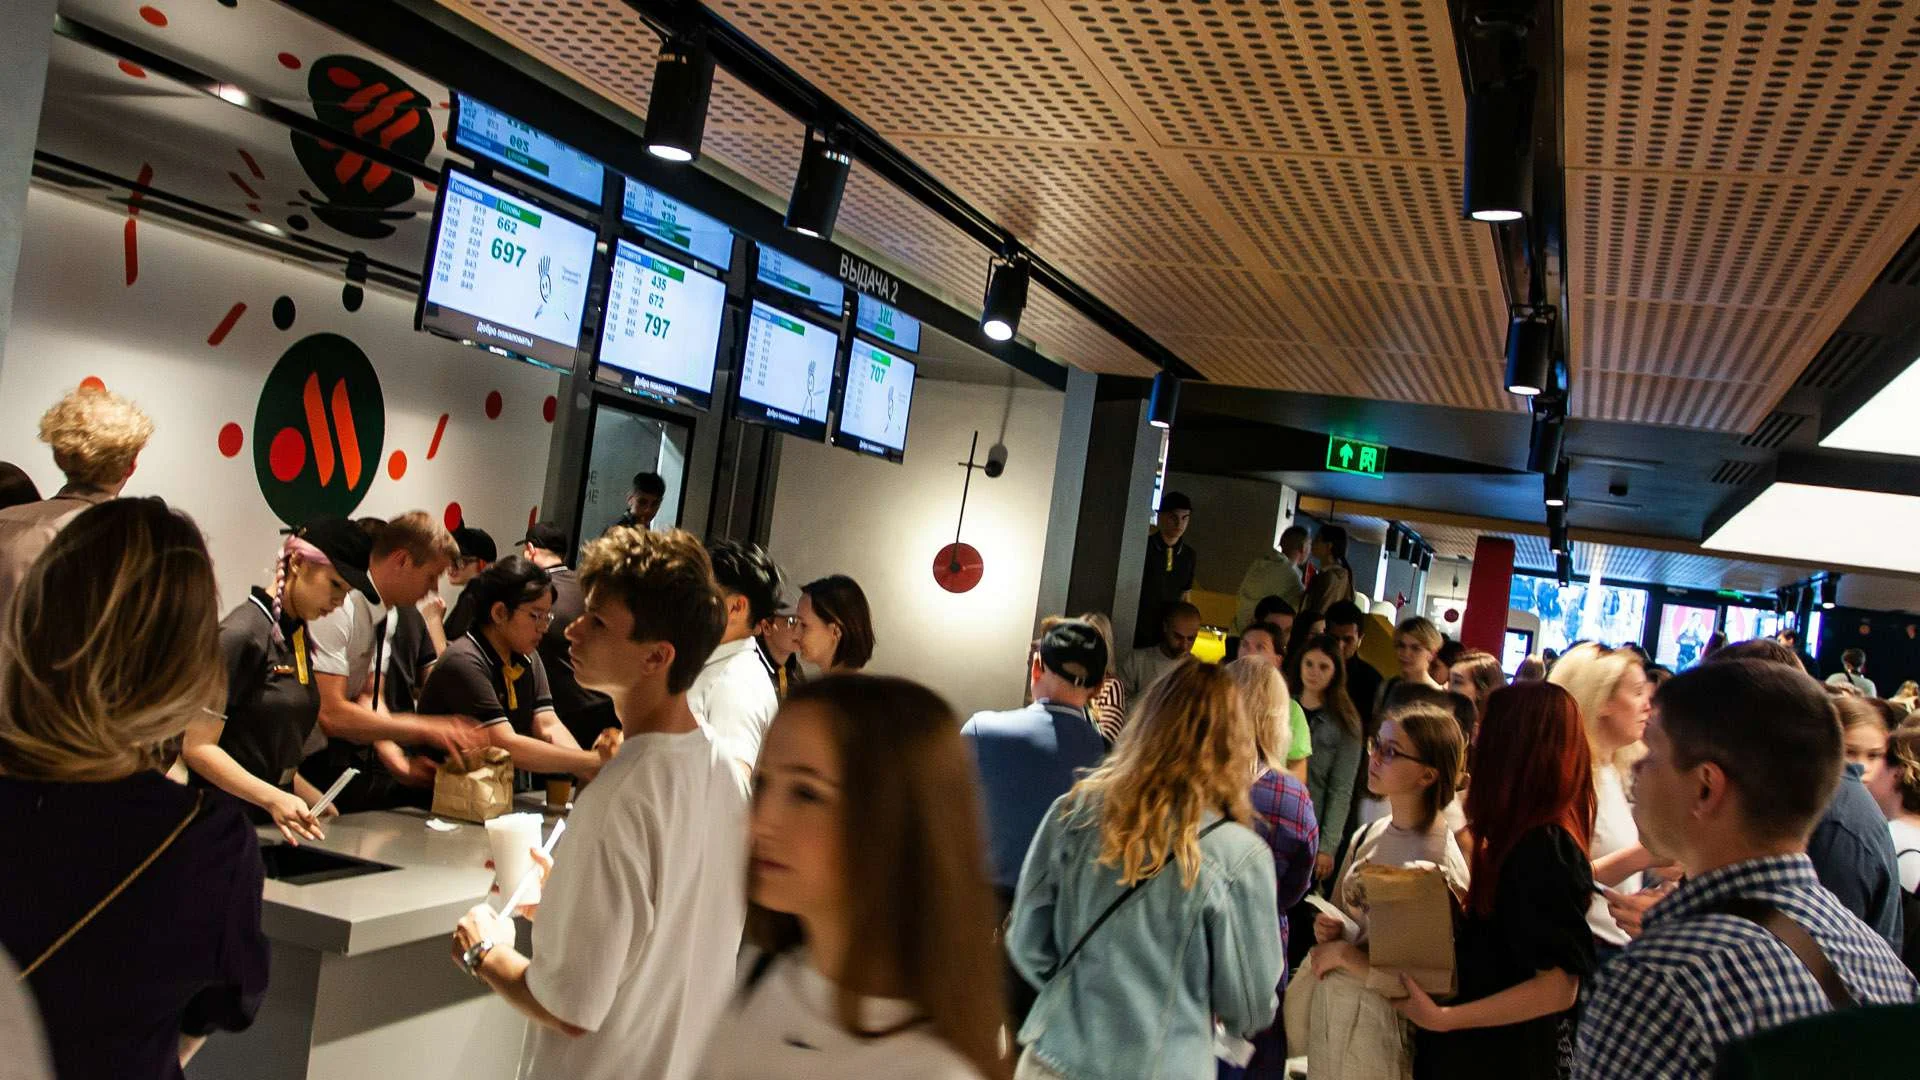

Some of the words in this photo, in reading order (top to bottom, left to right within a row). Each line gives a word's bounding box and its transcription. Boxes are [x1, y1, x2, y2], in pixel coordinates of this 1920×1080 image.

[497, 216, 517, 235] 662
[491, 238, 527, 268] 697
[651, 275, 667, 291] 435
[839, 253, 890, 299] ВЫДАЧА
[890, 281, 899, 303] 2
[648, 292, 664, 309] 672
[476, 321, 497, 337] Добро
[497, 329, 533, 348] пожаловать!
[644, 312, 671, 340] 797
[870, 364, 886, 385] 707
